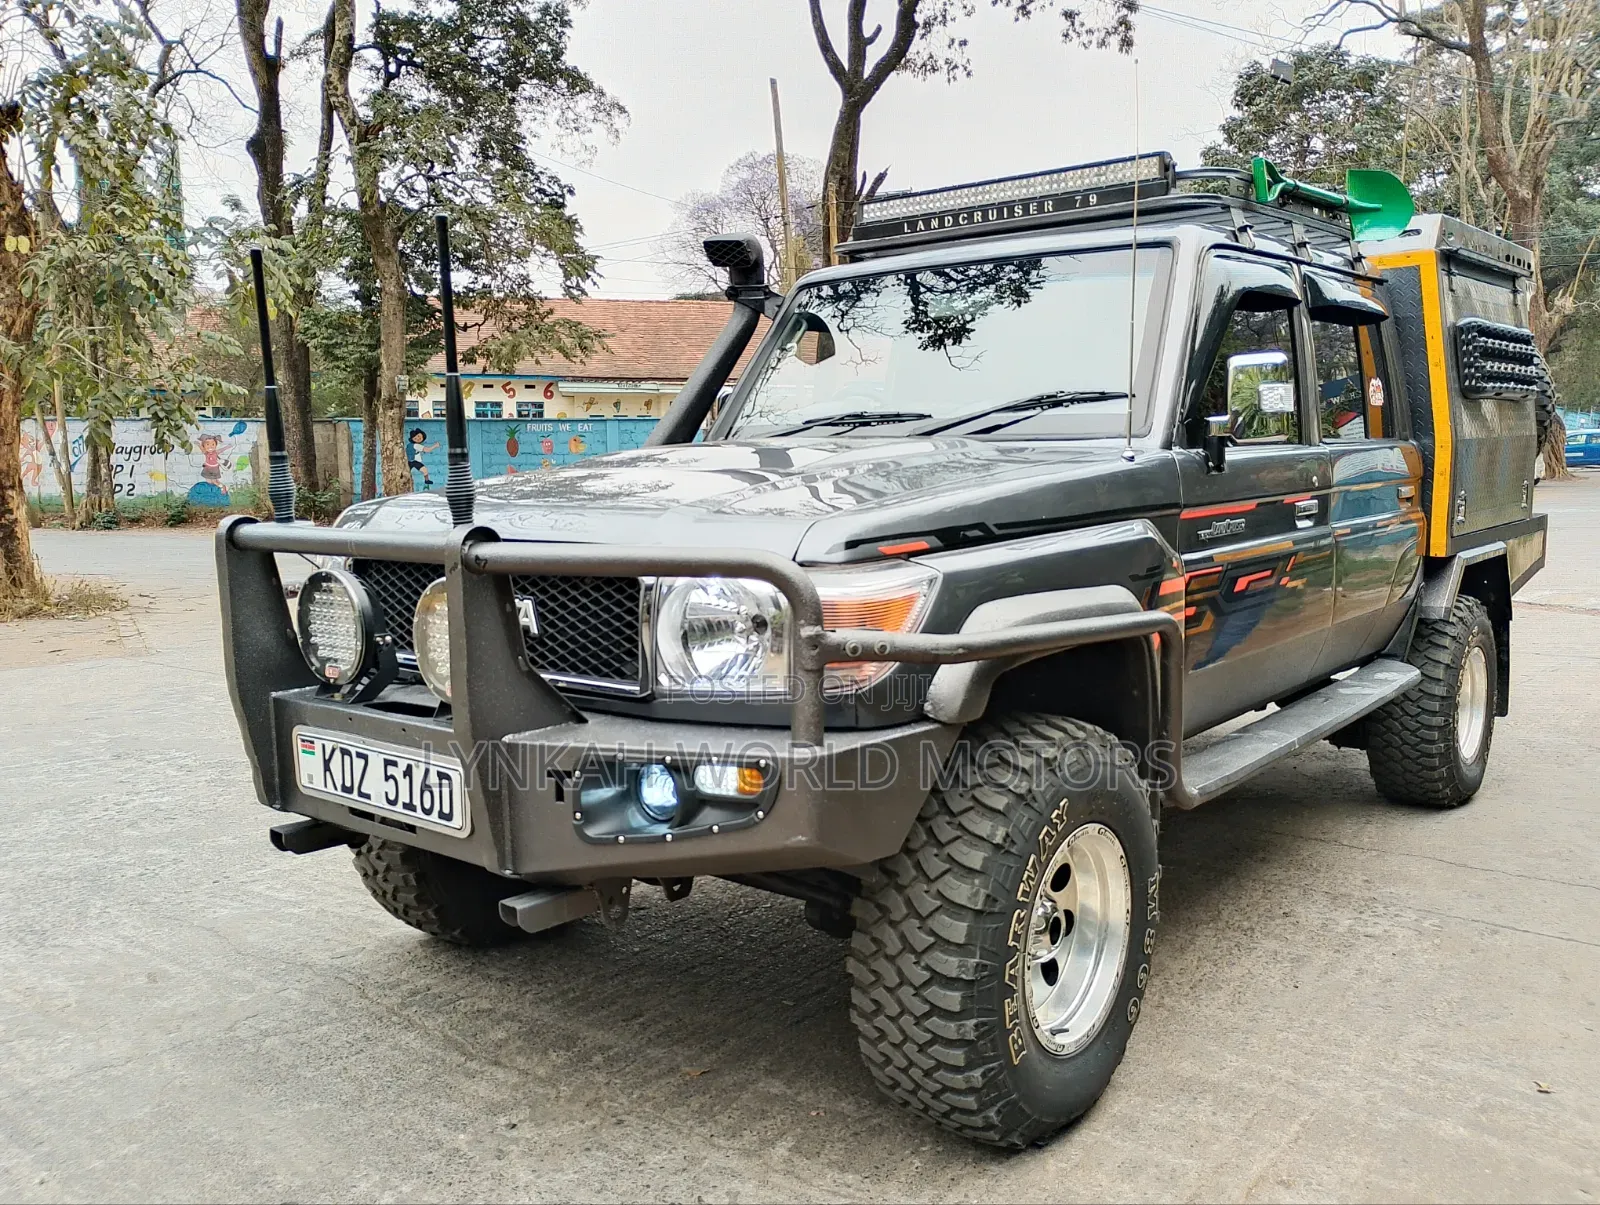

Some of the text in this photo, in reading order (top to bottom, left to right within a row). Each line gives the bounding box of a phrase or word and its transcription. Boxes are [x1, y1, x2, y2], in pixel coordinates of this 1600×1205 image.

[903, 193, 1098, 233] LANDCRUISER 79
[501, 381, 516, 399] 5
[543, 382, 554, 400] 6
[526, 423, 593, 432] FRUITS WE EAT
[126, 483, 136, 496] 2
[321, 743, 454, 823] KDZ 516D
